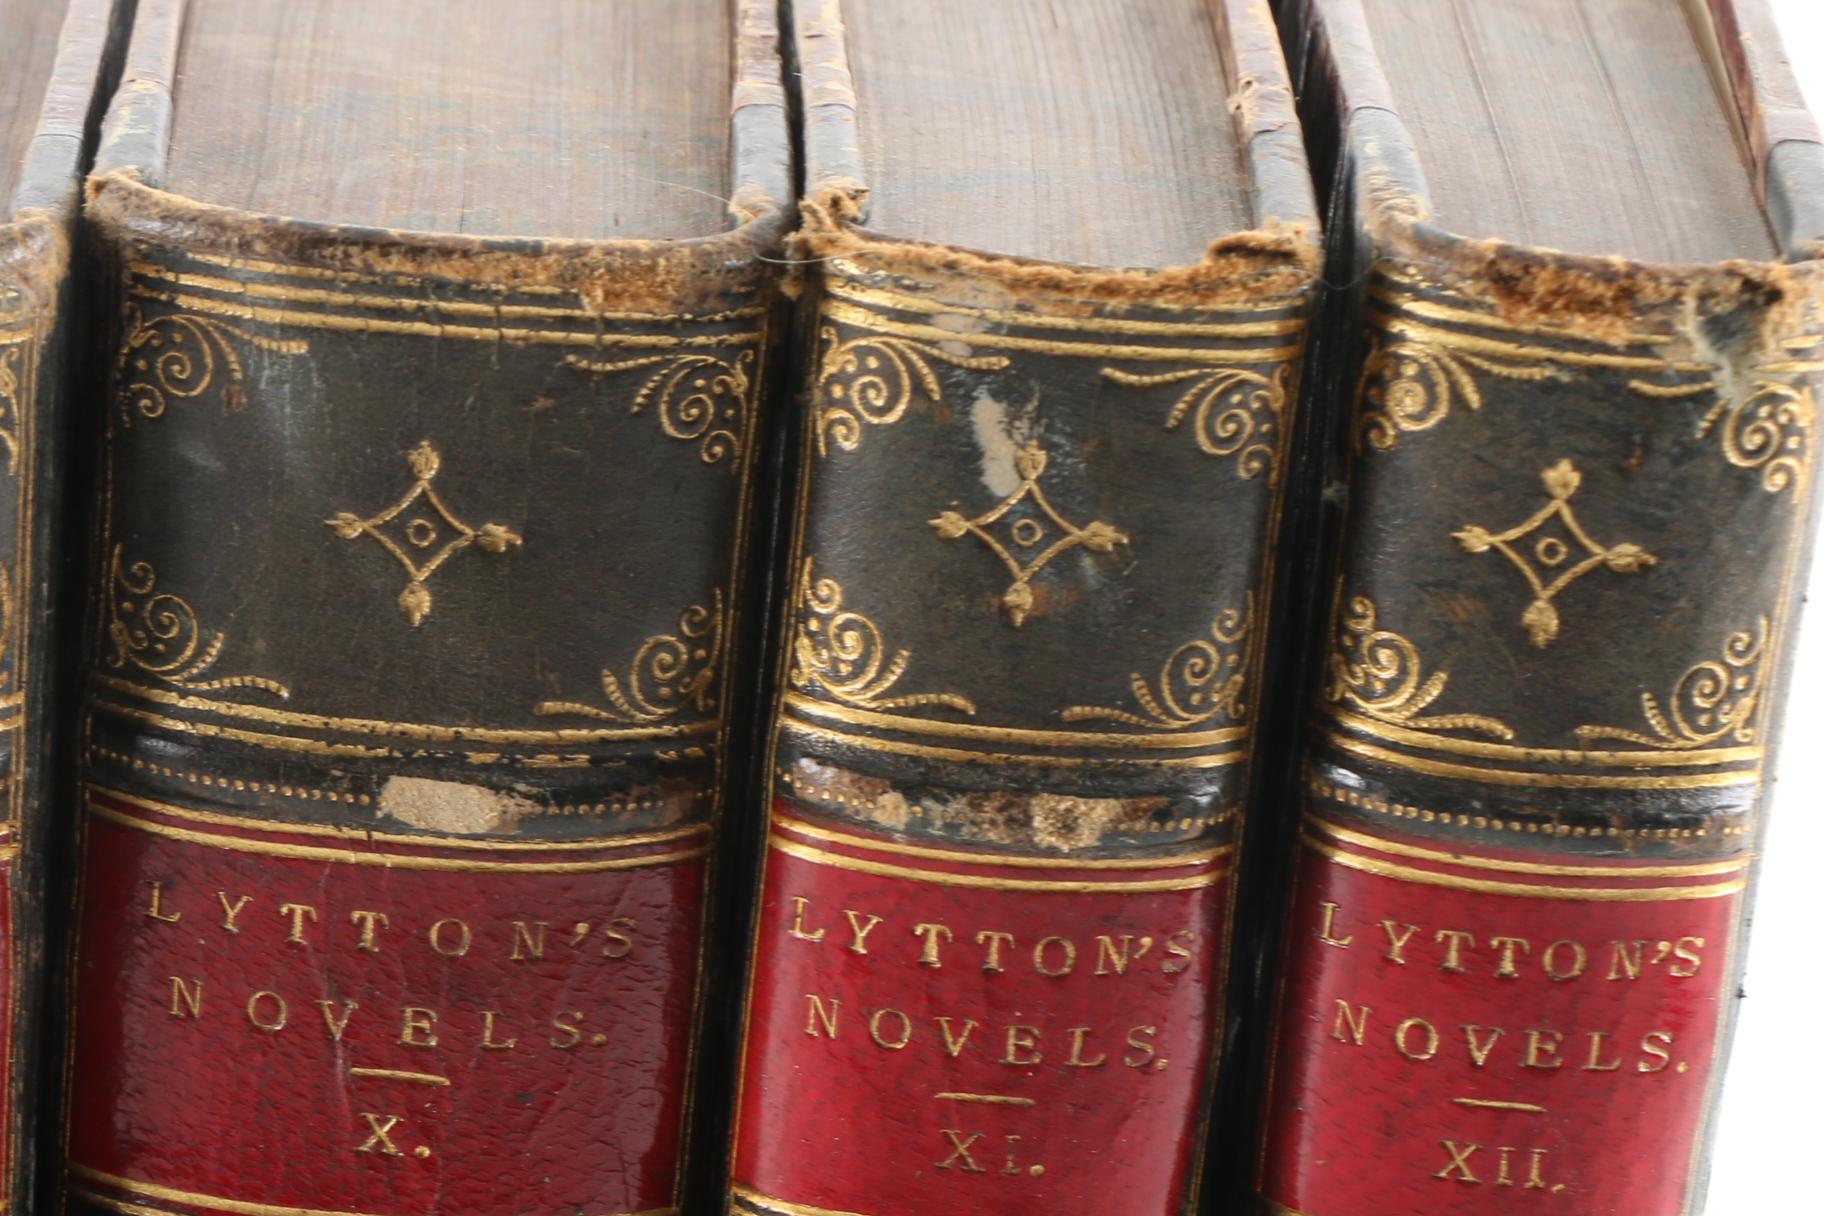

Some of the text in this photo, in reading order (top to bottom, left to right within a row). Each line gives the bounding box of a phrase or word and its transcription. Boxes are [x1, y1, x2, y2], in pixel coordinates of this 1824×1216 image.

[143, 881, 637, 960] LYTTON'S
[787, 896, 1196, 977] LYTTON'S
[1319, 901, 1705, 980] LYTTON'S
[168, 976, 608, 1050] NOVELS.
[804, 993, 1170, 1070] NOVELS.
[1329, 999, 1689, 1073] NOVELS.
[356, 1112, 431, 1159] X.
[934, 1128, 1046, 1178] XI.
[1432, 1140, 1567, 1193] XII.
